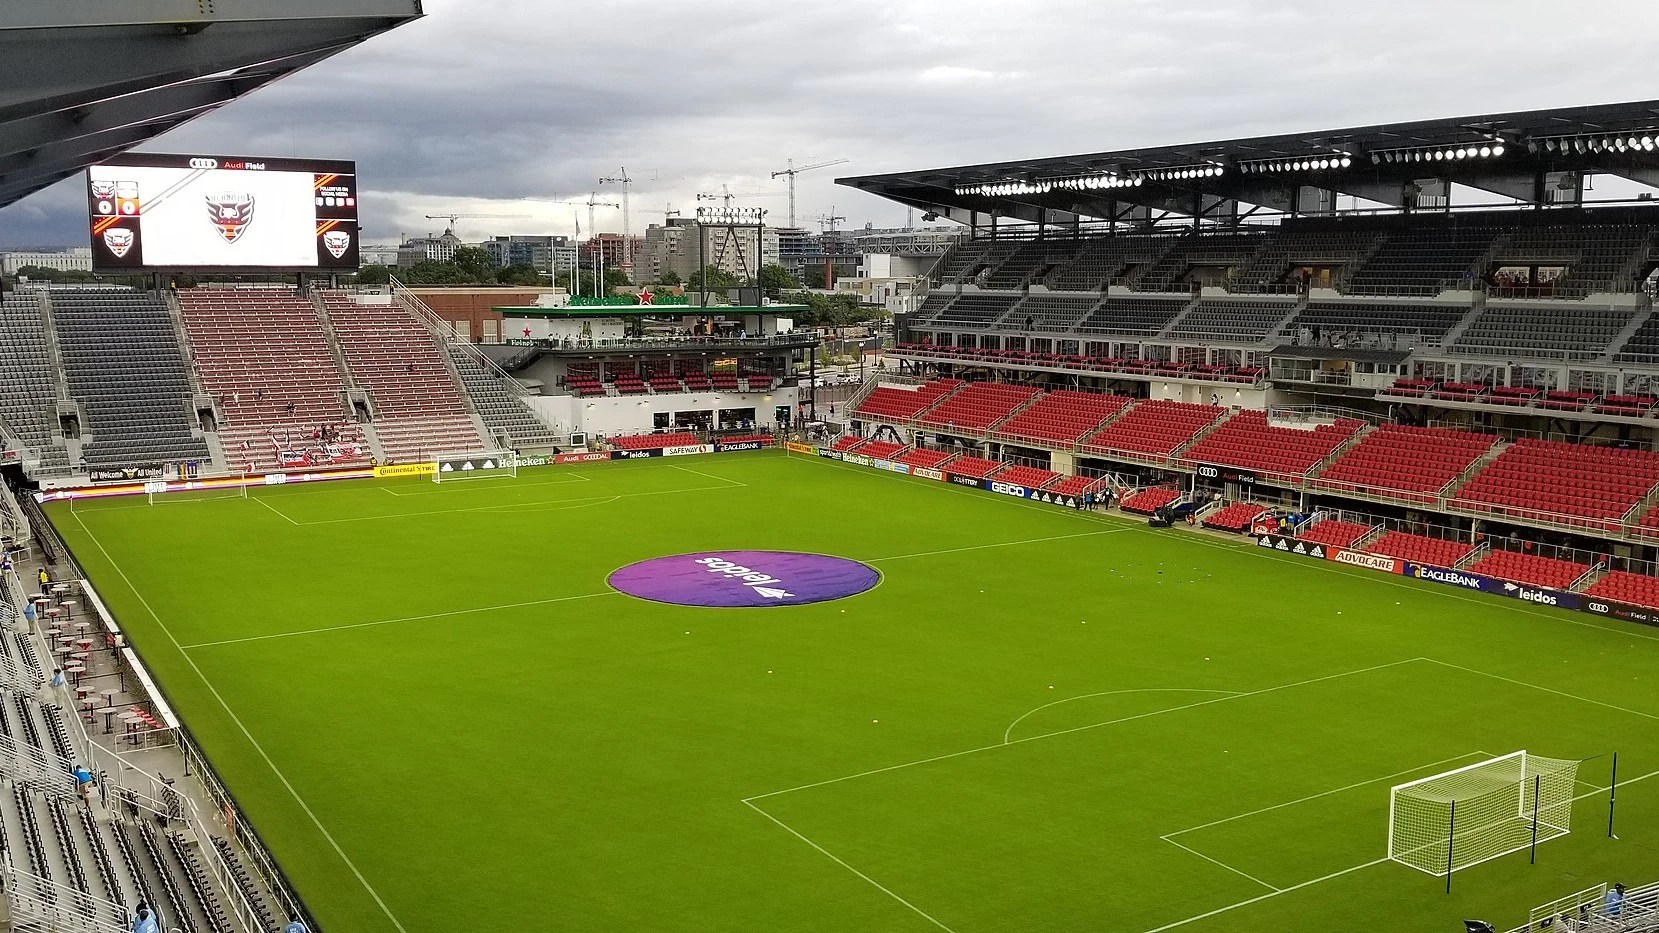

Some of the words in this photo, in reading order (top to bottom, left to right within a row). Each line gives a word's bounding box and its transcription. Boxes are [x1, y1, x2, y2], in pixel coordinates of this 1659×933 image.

[245, 162, 265, 170] Field
[629, 451, 650, 459] leidos
[669, 447, 698, 455] SAFEWAY
[499, 458, 546, 468] Heineken
[842, 453, 869, 466] Heineken
[99, 471, 123, 480] Welcome
[1222, 472, 1238, 481] Audi
[1238, 474, 1254, 483] Field
[991, 481, 1025, 498] GEICO
[1336, 552, 1393, 570] ADVOCARE
[695, 557, 781, 586] leidos
[1519, 587, 1557, 605] leidos
[1630, 612, 1647, 620] Field
